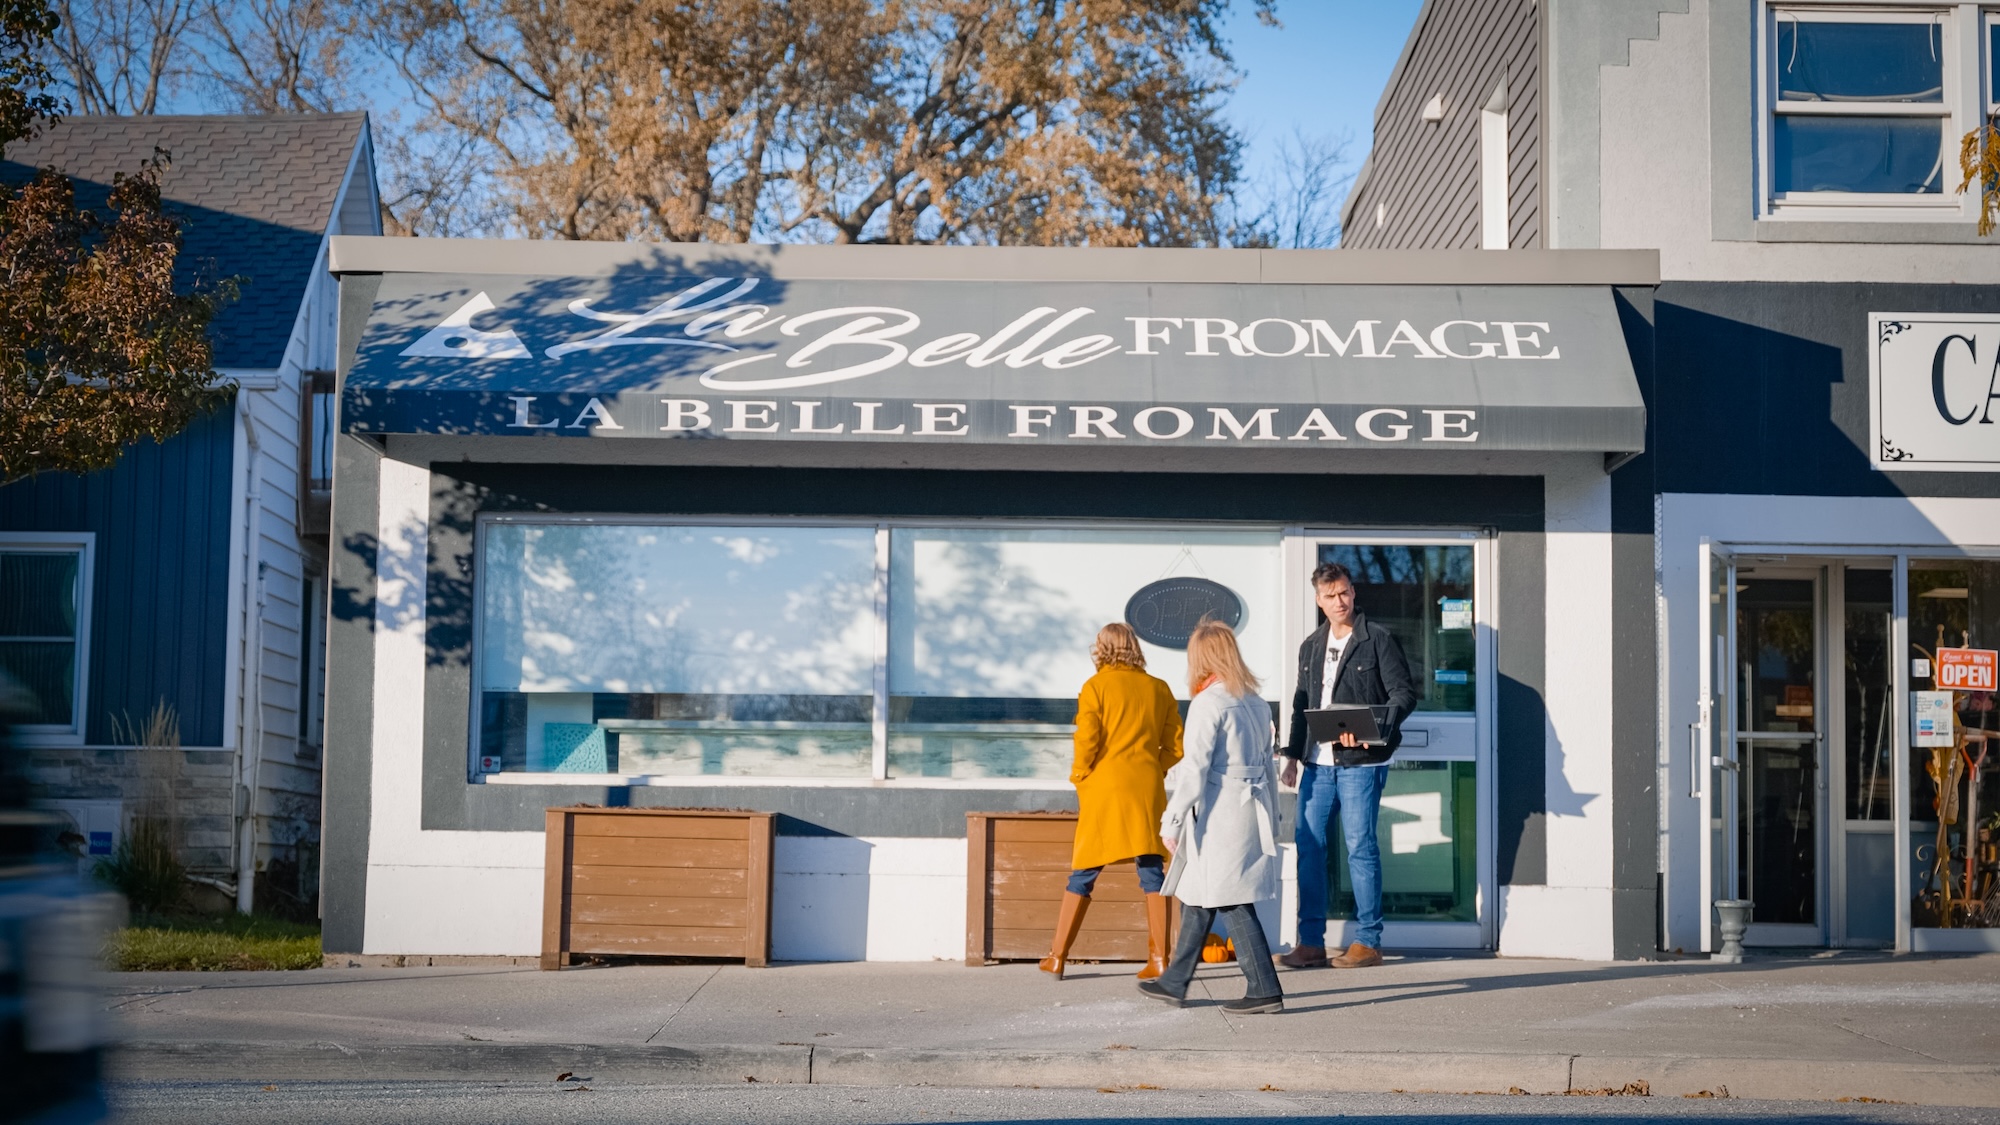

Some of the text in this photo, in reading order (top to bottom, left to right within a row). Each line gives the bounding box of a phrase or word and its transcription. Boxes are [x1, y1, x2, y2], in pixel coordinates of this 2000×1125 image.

[544, 277, 1562, 391] La Belle FROMAGE
[506, 396, 1480, 442] LA BELLE FROMAGE
[1942, 663, 1992, 687] OPEN
